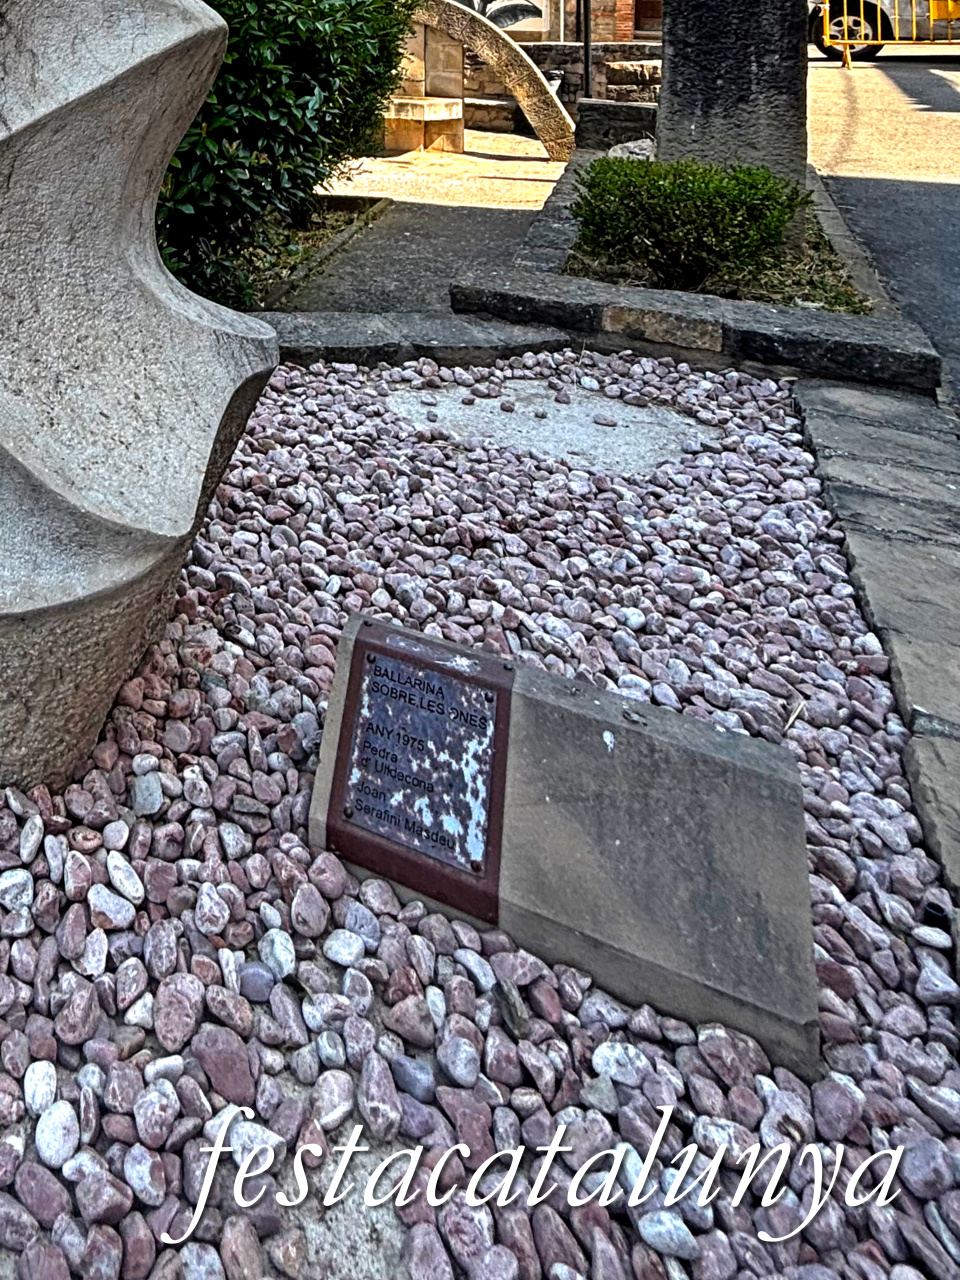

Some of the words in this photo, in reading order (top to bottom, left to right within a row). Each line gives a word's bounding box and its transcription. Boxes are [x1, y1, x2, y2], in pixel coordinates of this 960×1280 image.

[371, 681, 416, 705] SOBRE
[420, 697, 445, 715] LES
[373, 665, 445, 701] BALLARINA
[362, 741, 398, 763] Pedra
[366, 722, 394, 740] ANY
[396, 733, 425, 752] 1975
[357, 782, 386, 801] Joan
[355, 798, 401, 827] Serafini
[404, 818, 455, 850] Masdeu
